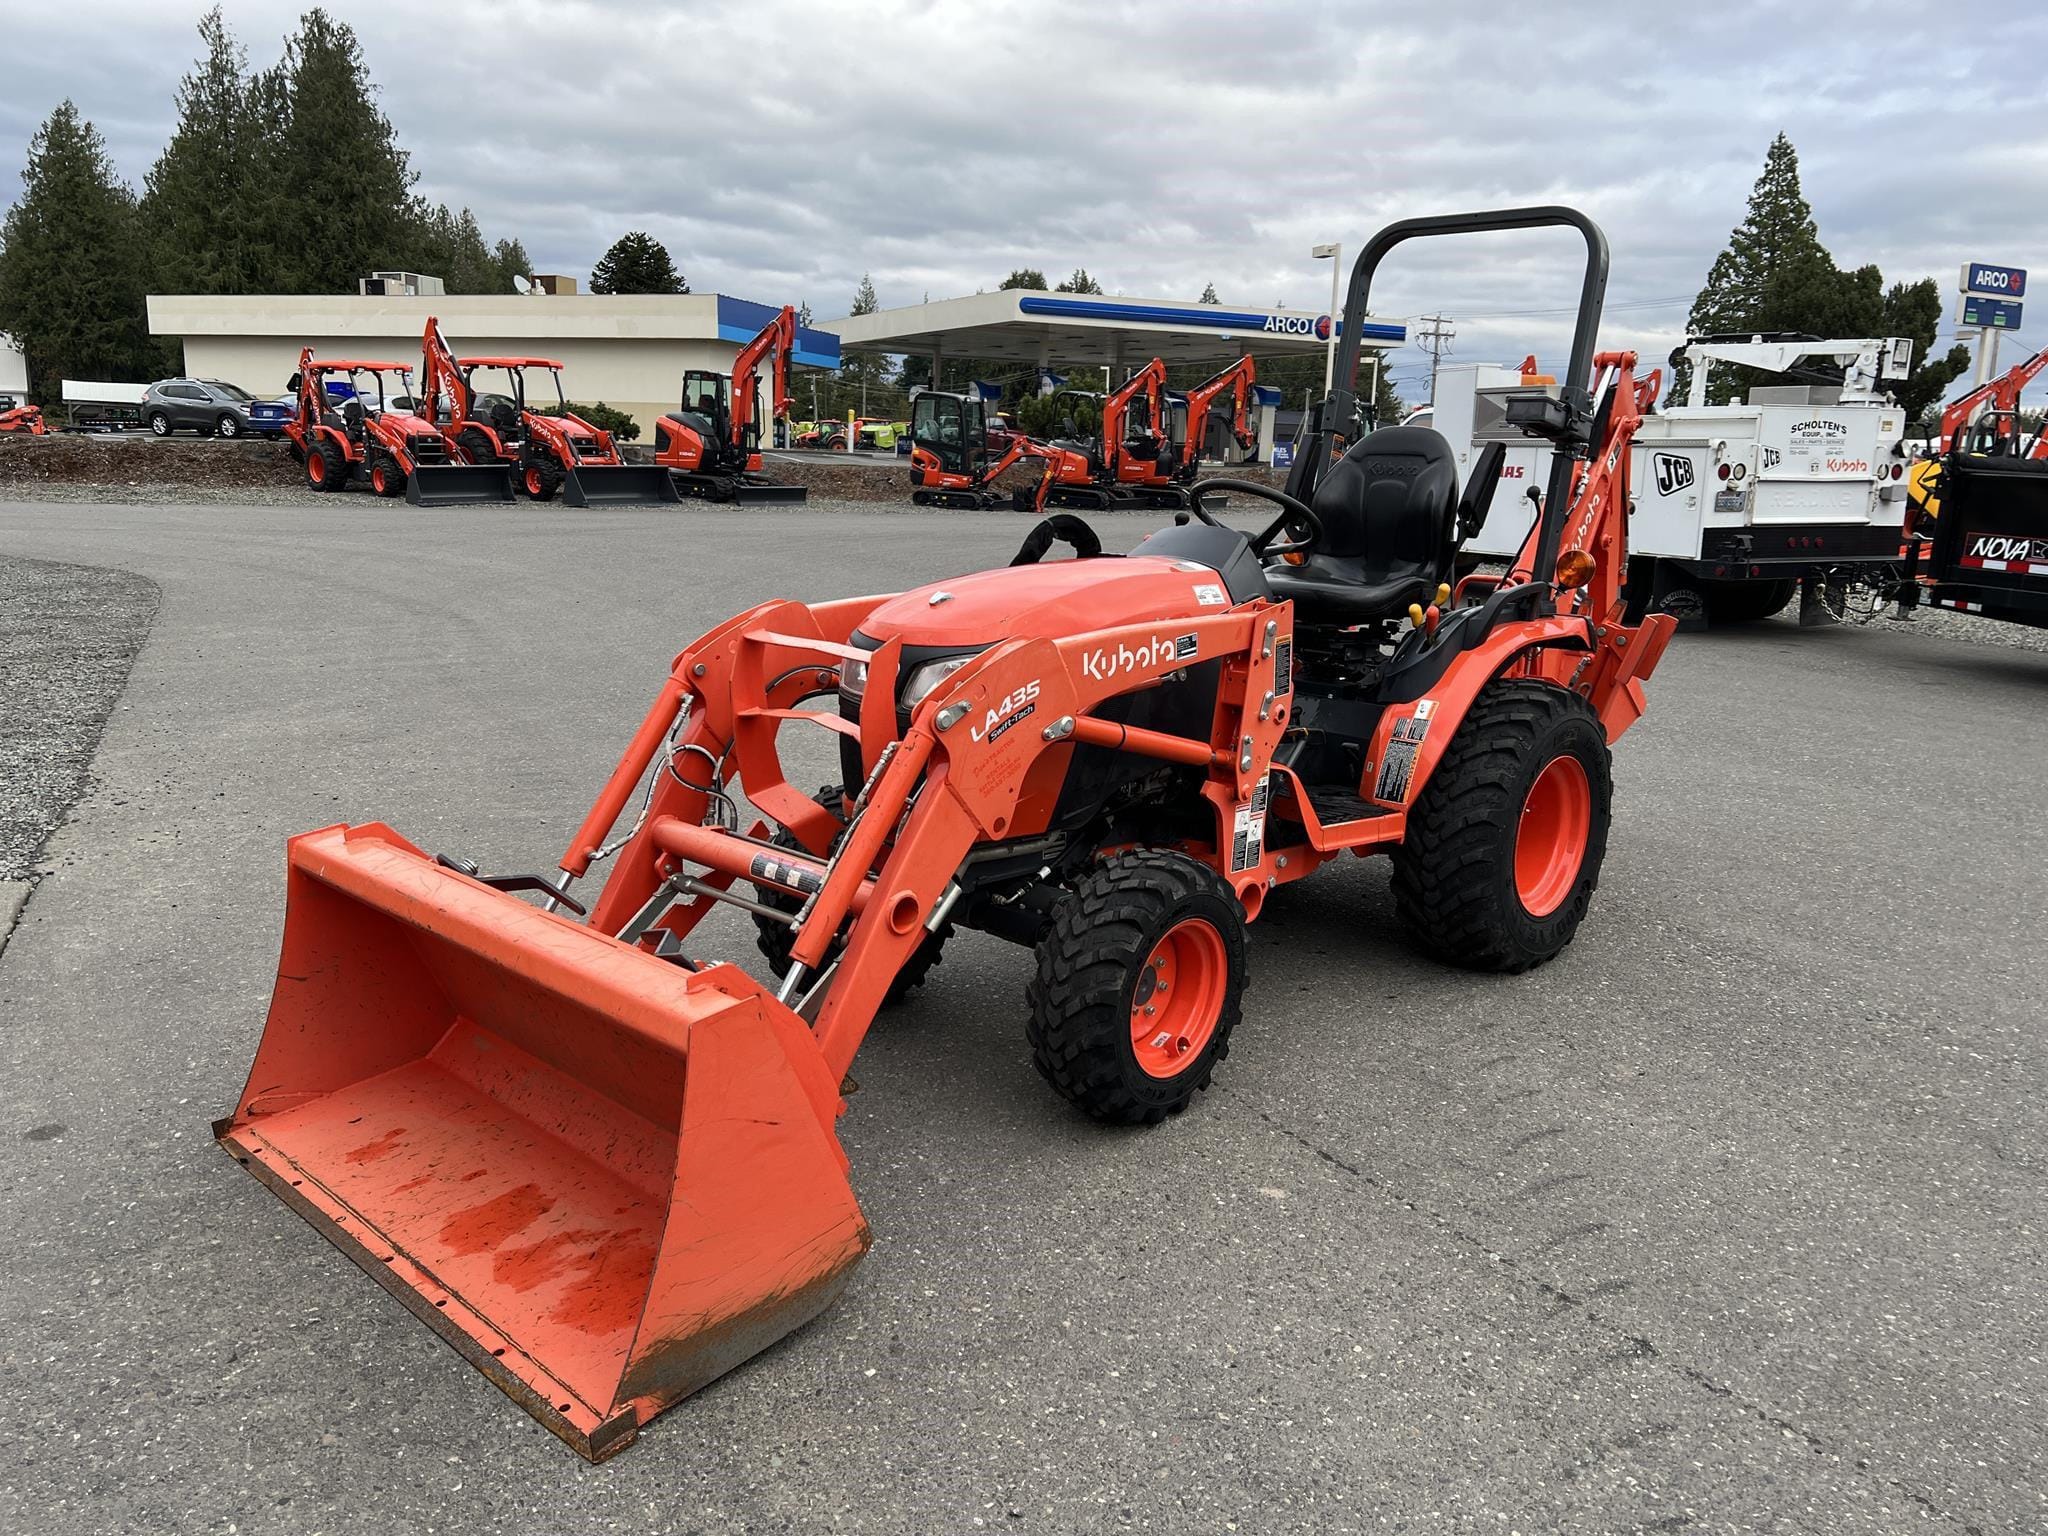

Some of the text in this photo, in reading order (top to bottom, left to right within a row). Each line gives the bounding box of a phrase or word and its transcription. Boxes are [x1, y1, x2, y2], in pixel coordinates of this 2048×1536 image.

[1975, 270, 2008, 288] ARCO
[1263, 316, 1309, 334] ARCO
[444, 371, 461, 419] Kubota
[529, 418, 551, 439] Kubota
[1791, 420, 1848, 434] SCHOLTEN'S
[1763, 448, 1781, 469] JCB
[1827, 458, 1868, 473] Kubota
[1659, 456, 1692, 492] JCB
[1572, 494, 1600, 550] ubota
[1970, 537, 2031, 561] NOVA
[1083, 635, 1175, 680] Kubota
[970, 679, 1041, 743] LA435
[990, 704, 1034, 742] Swift-Tach
